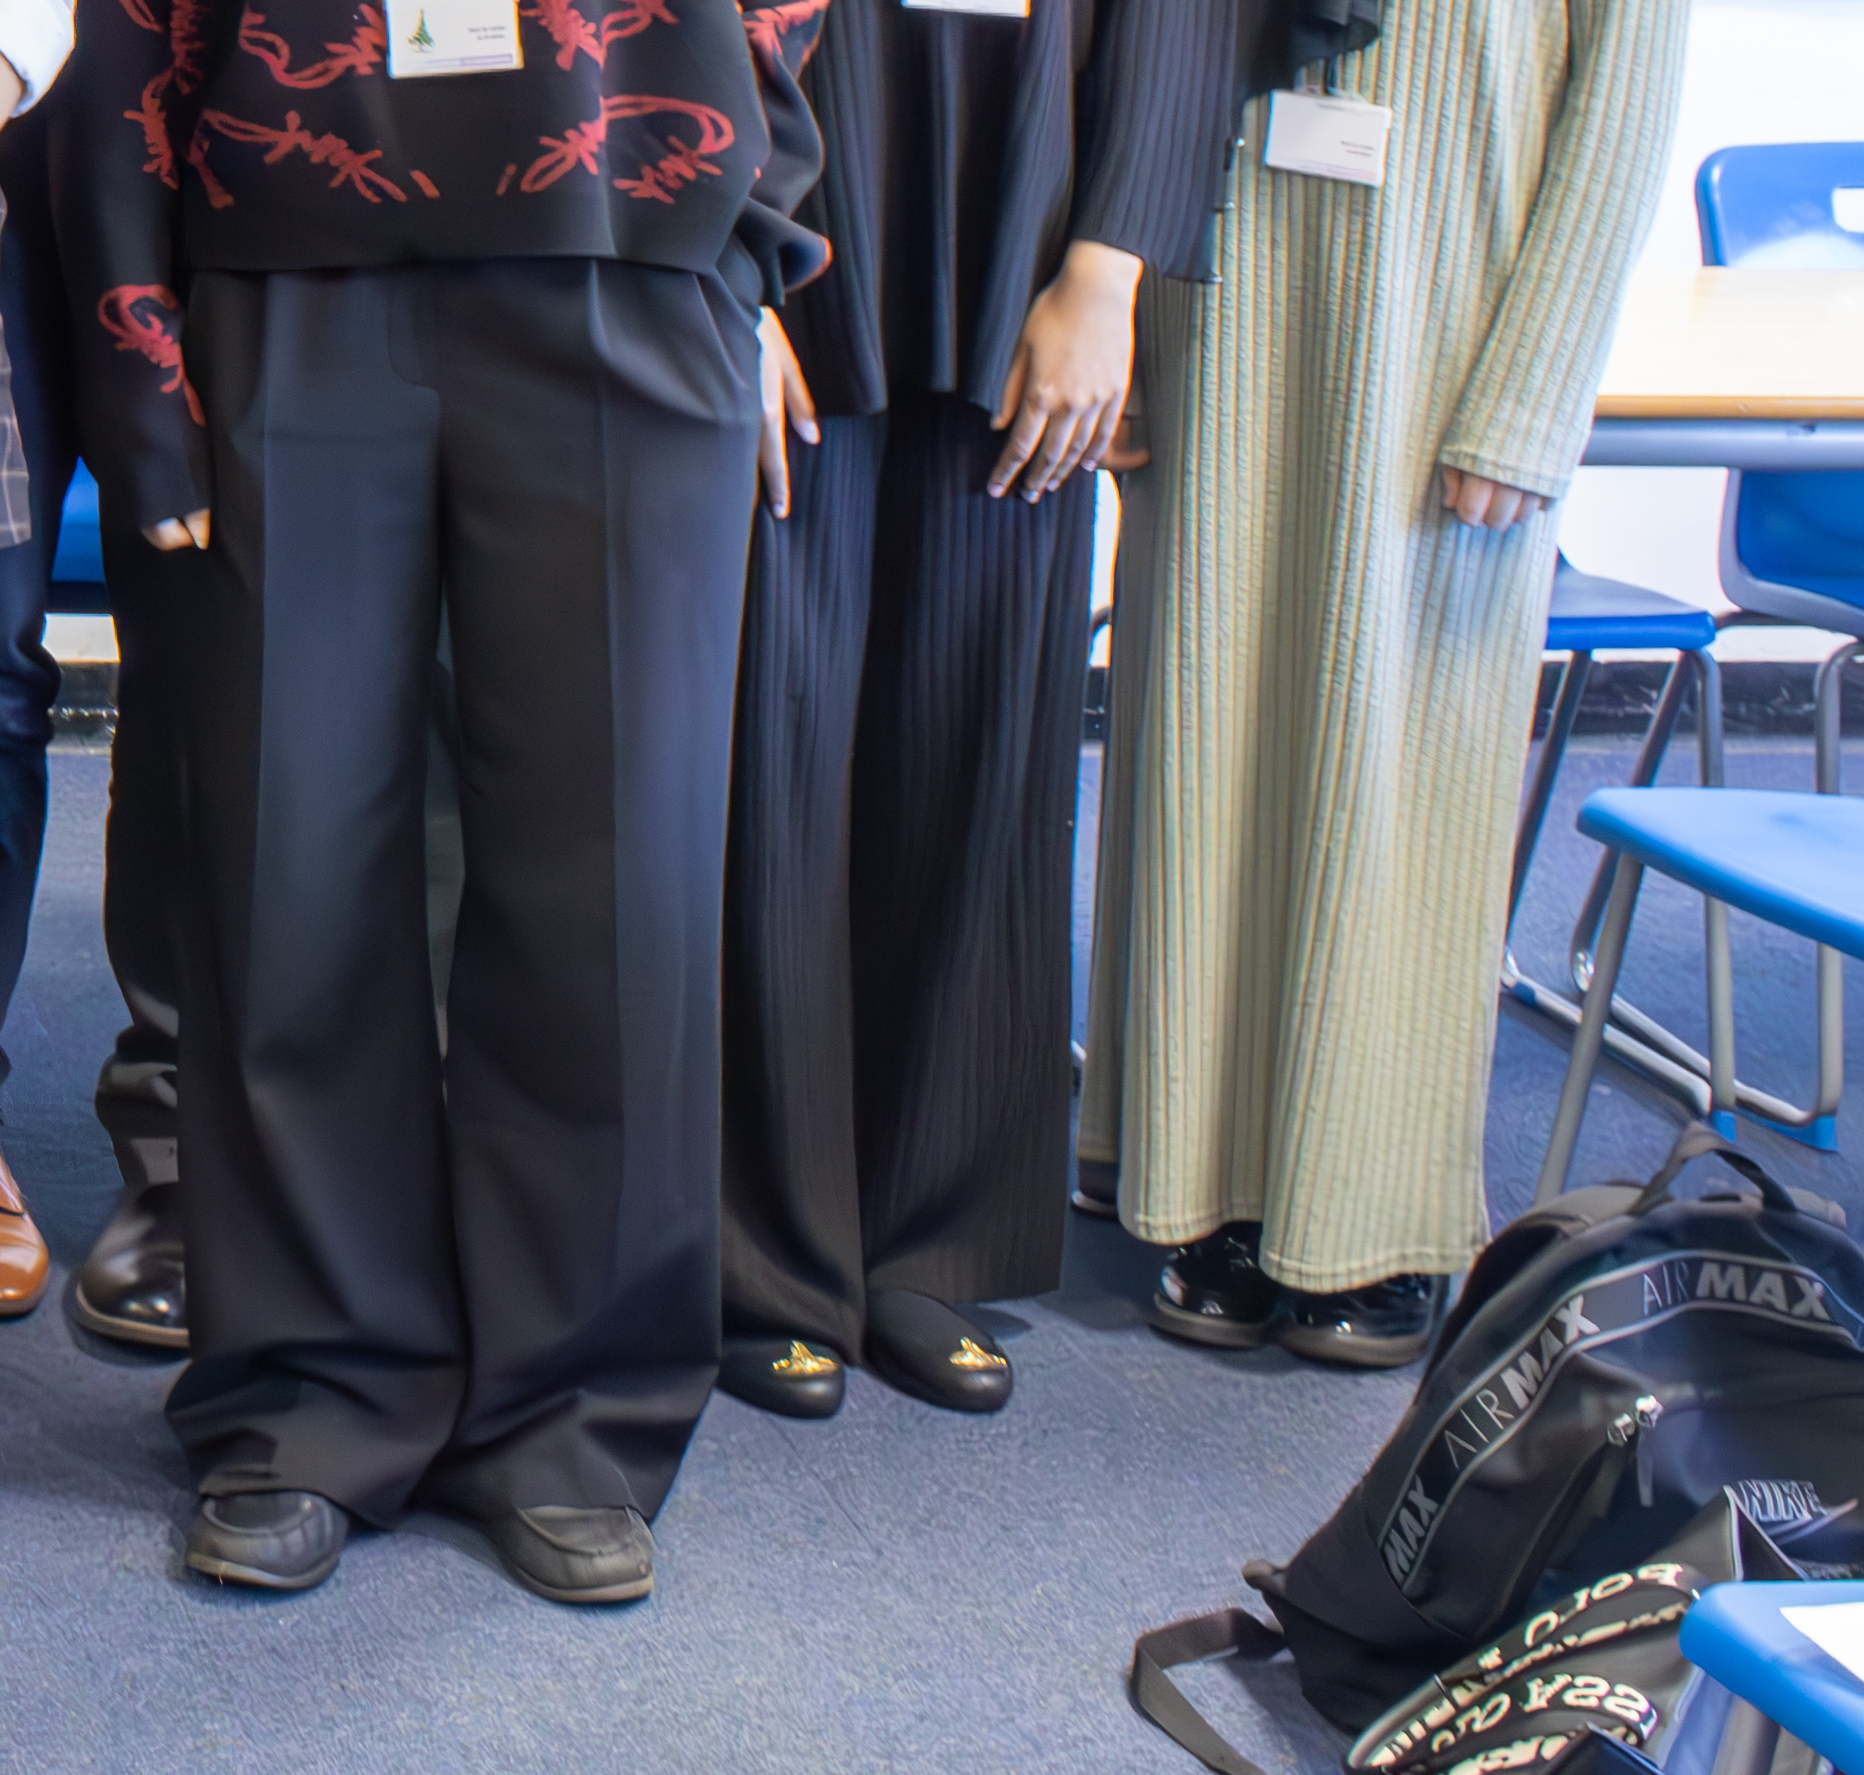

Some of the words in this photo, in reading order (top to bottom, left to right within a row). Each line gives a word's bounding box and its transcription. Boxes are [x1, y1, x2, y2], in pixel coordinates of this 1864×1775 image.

[1642, 1260, 1690, 1317] AIR
[1694, 1260, 1832, 1322] MAX
[1443, 1387, 1516, 1471] AIR
[1499, 1294, 1601, 1411] MAX
[1383, 1474, 1440, 1582] MAX
